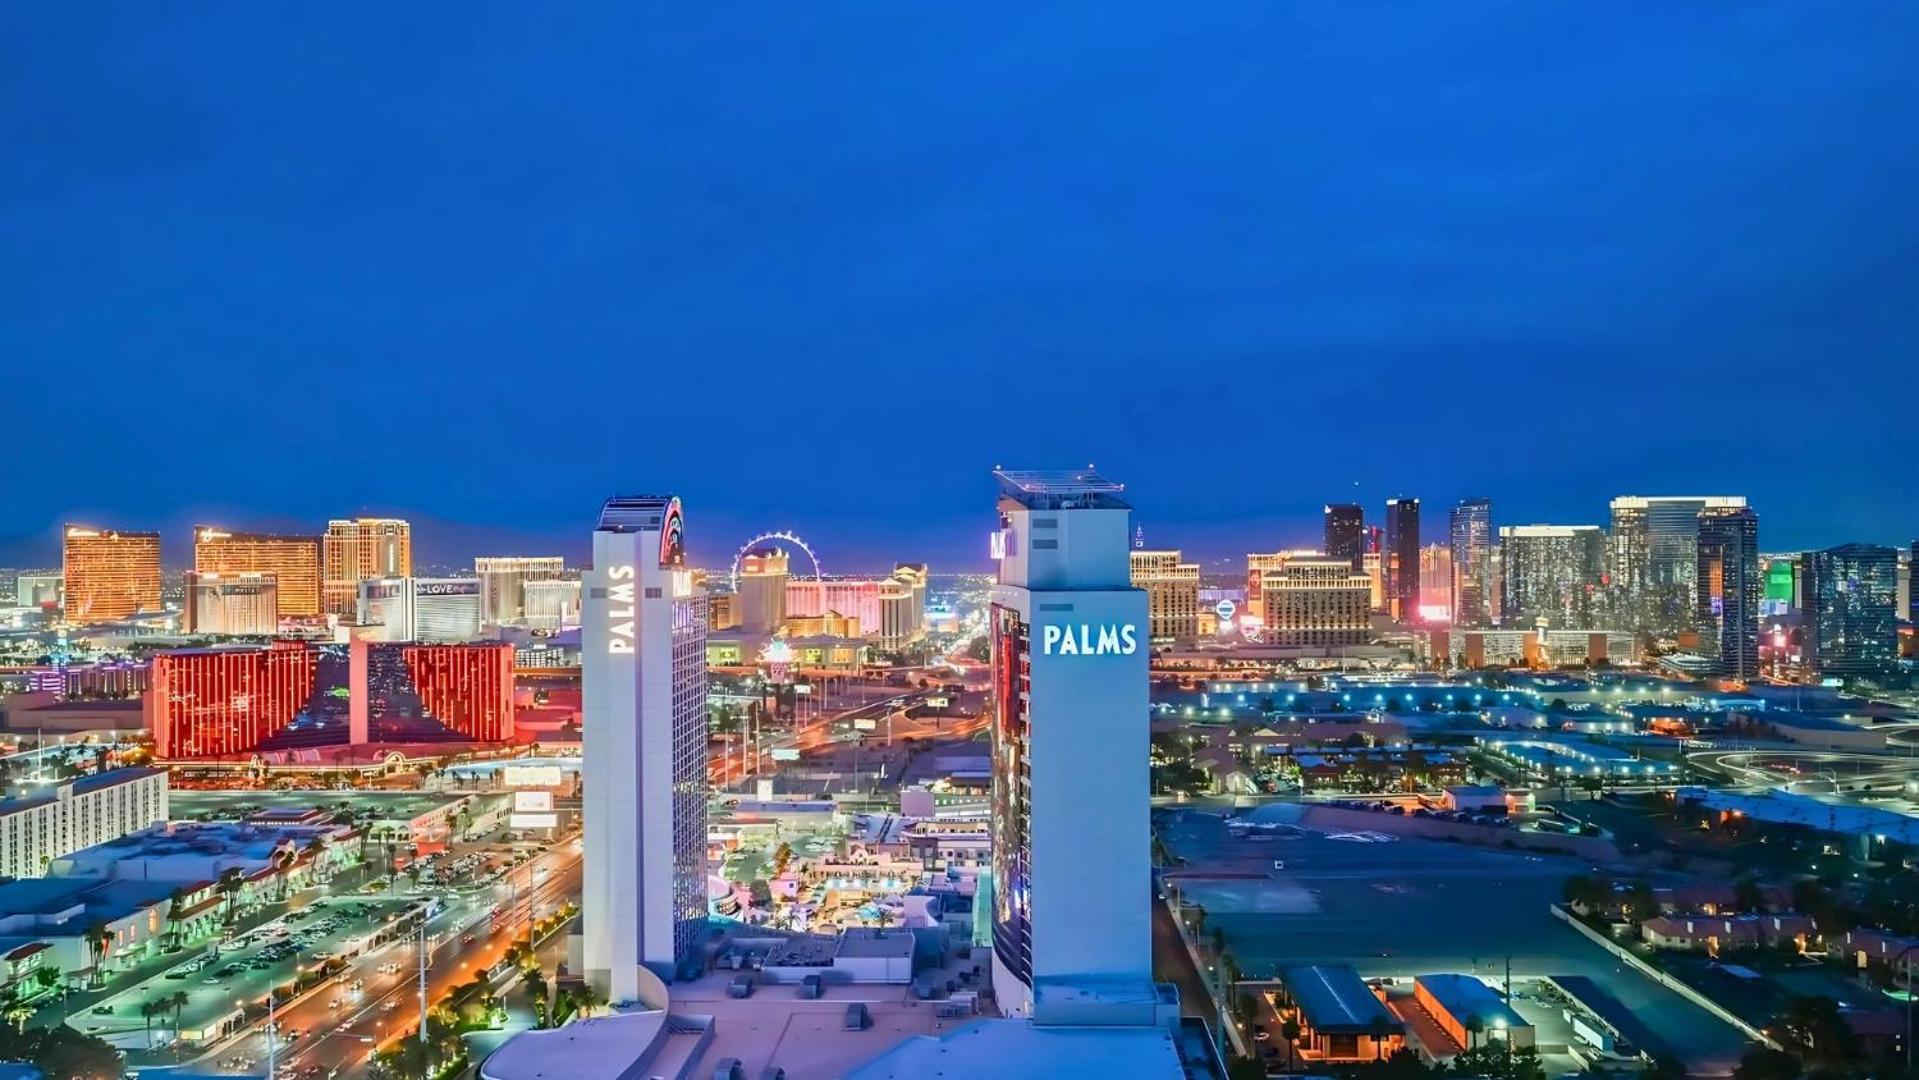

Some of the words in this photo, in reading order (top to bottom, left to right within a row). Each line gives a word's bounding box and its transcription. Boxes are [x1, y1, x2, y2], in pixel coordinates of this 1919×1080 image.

[427, 584, 454, 594] LOVE
[608, 565, 635, 654] PALMS
[1043, 623, 1137, 655] PALMS
